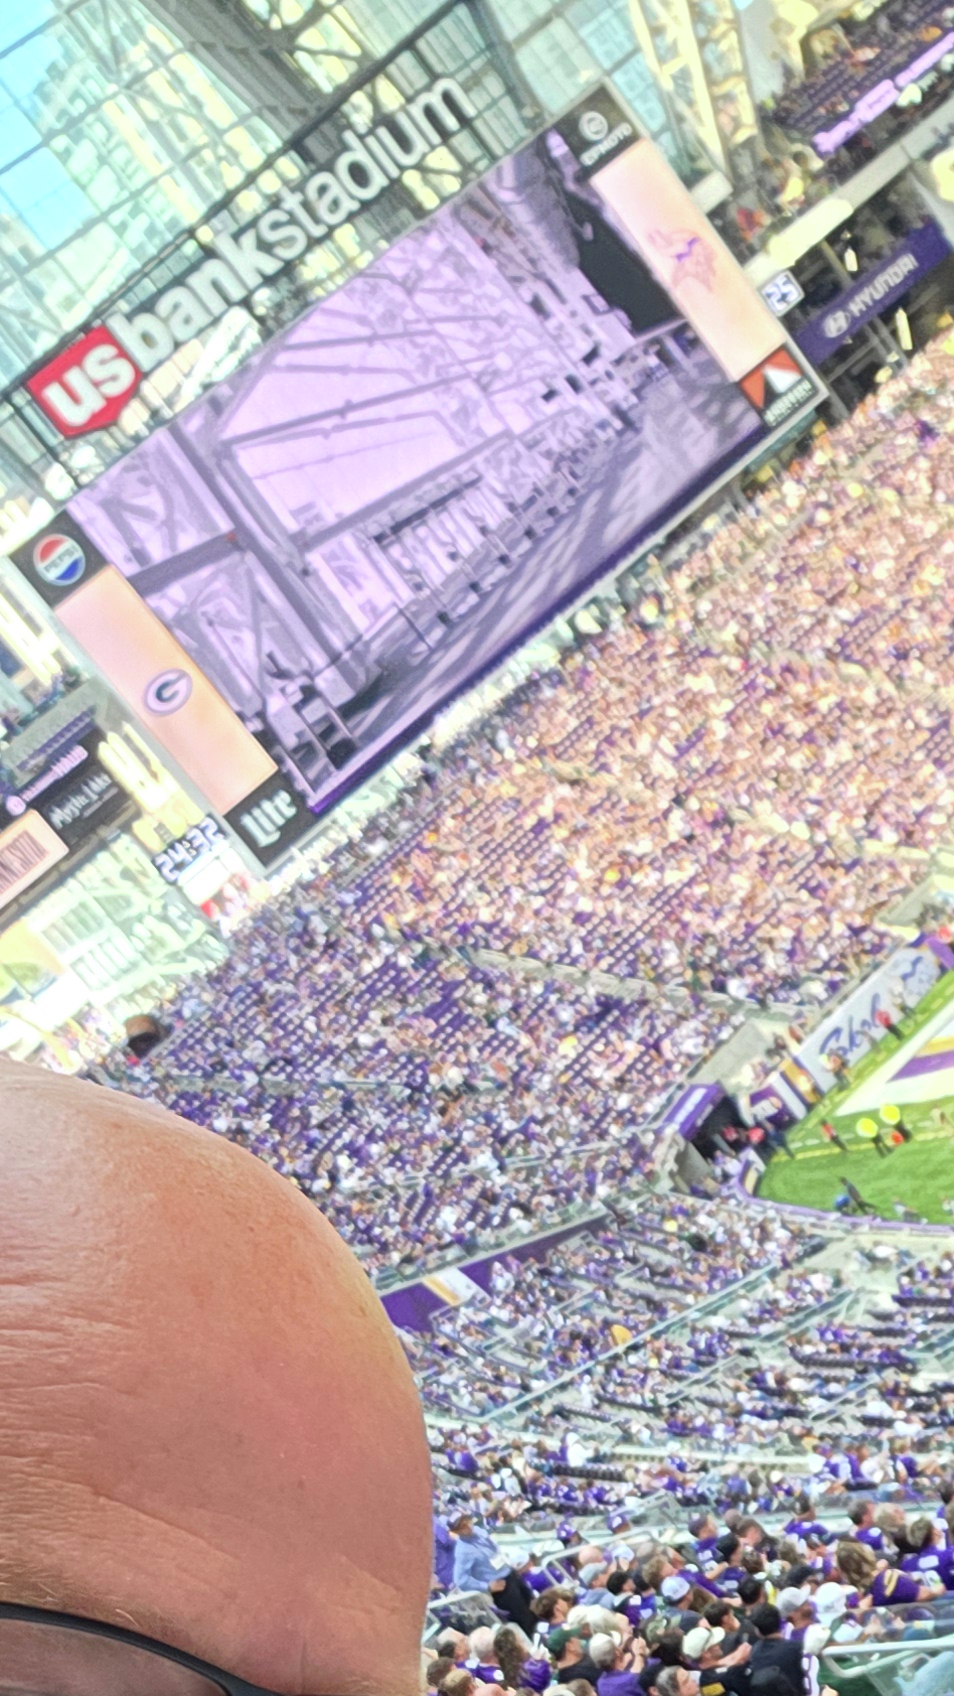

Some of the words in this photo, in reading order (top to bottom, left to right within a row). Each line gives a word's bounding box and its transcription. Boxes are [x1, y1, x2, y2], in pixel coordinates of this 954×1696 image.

[760, 274, 800, 312] 25
[847, 252, 920, 317] HYUNDAI
[154, 815, 229, 883] 24:32
